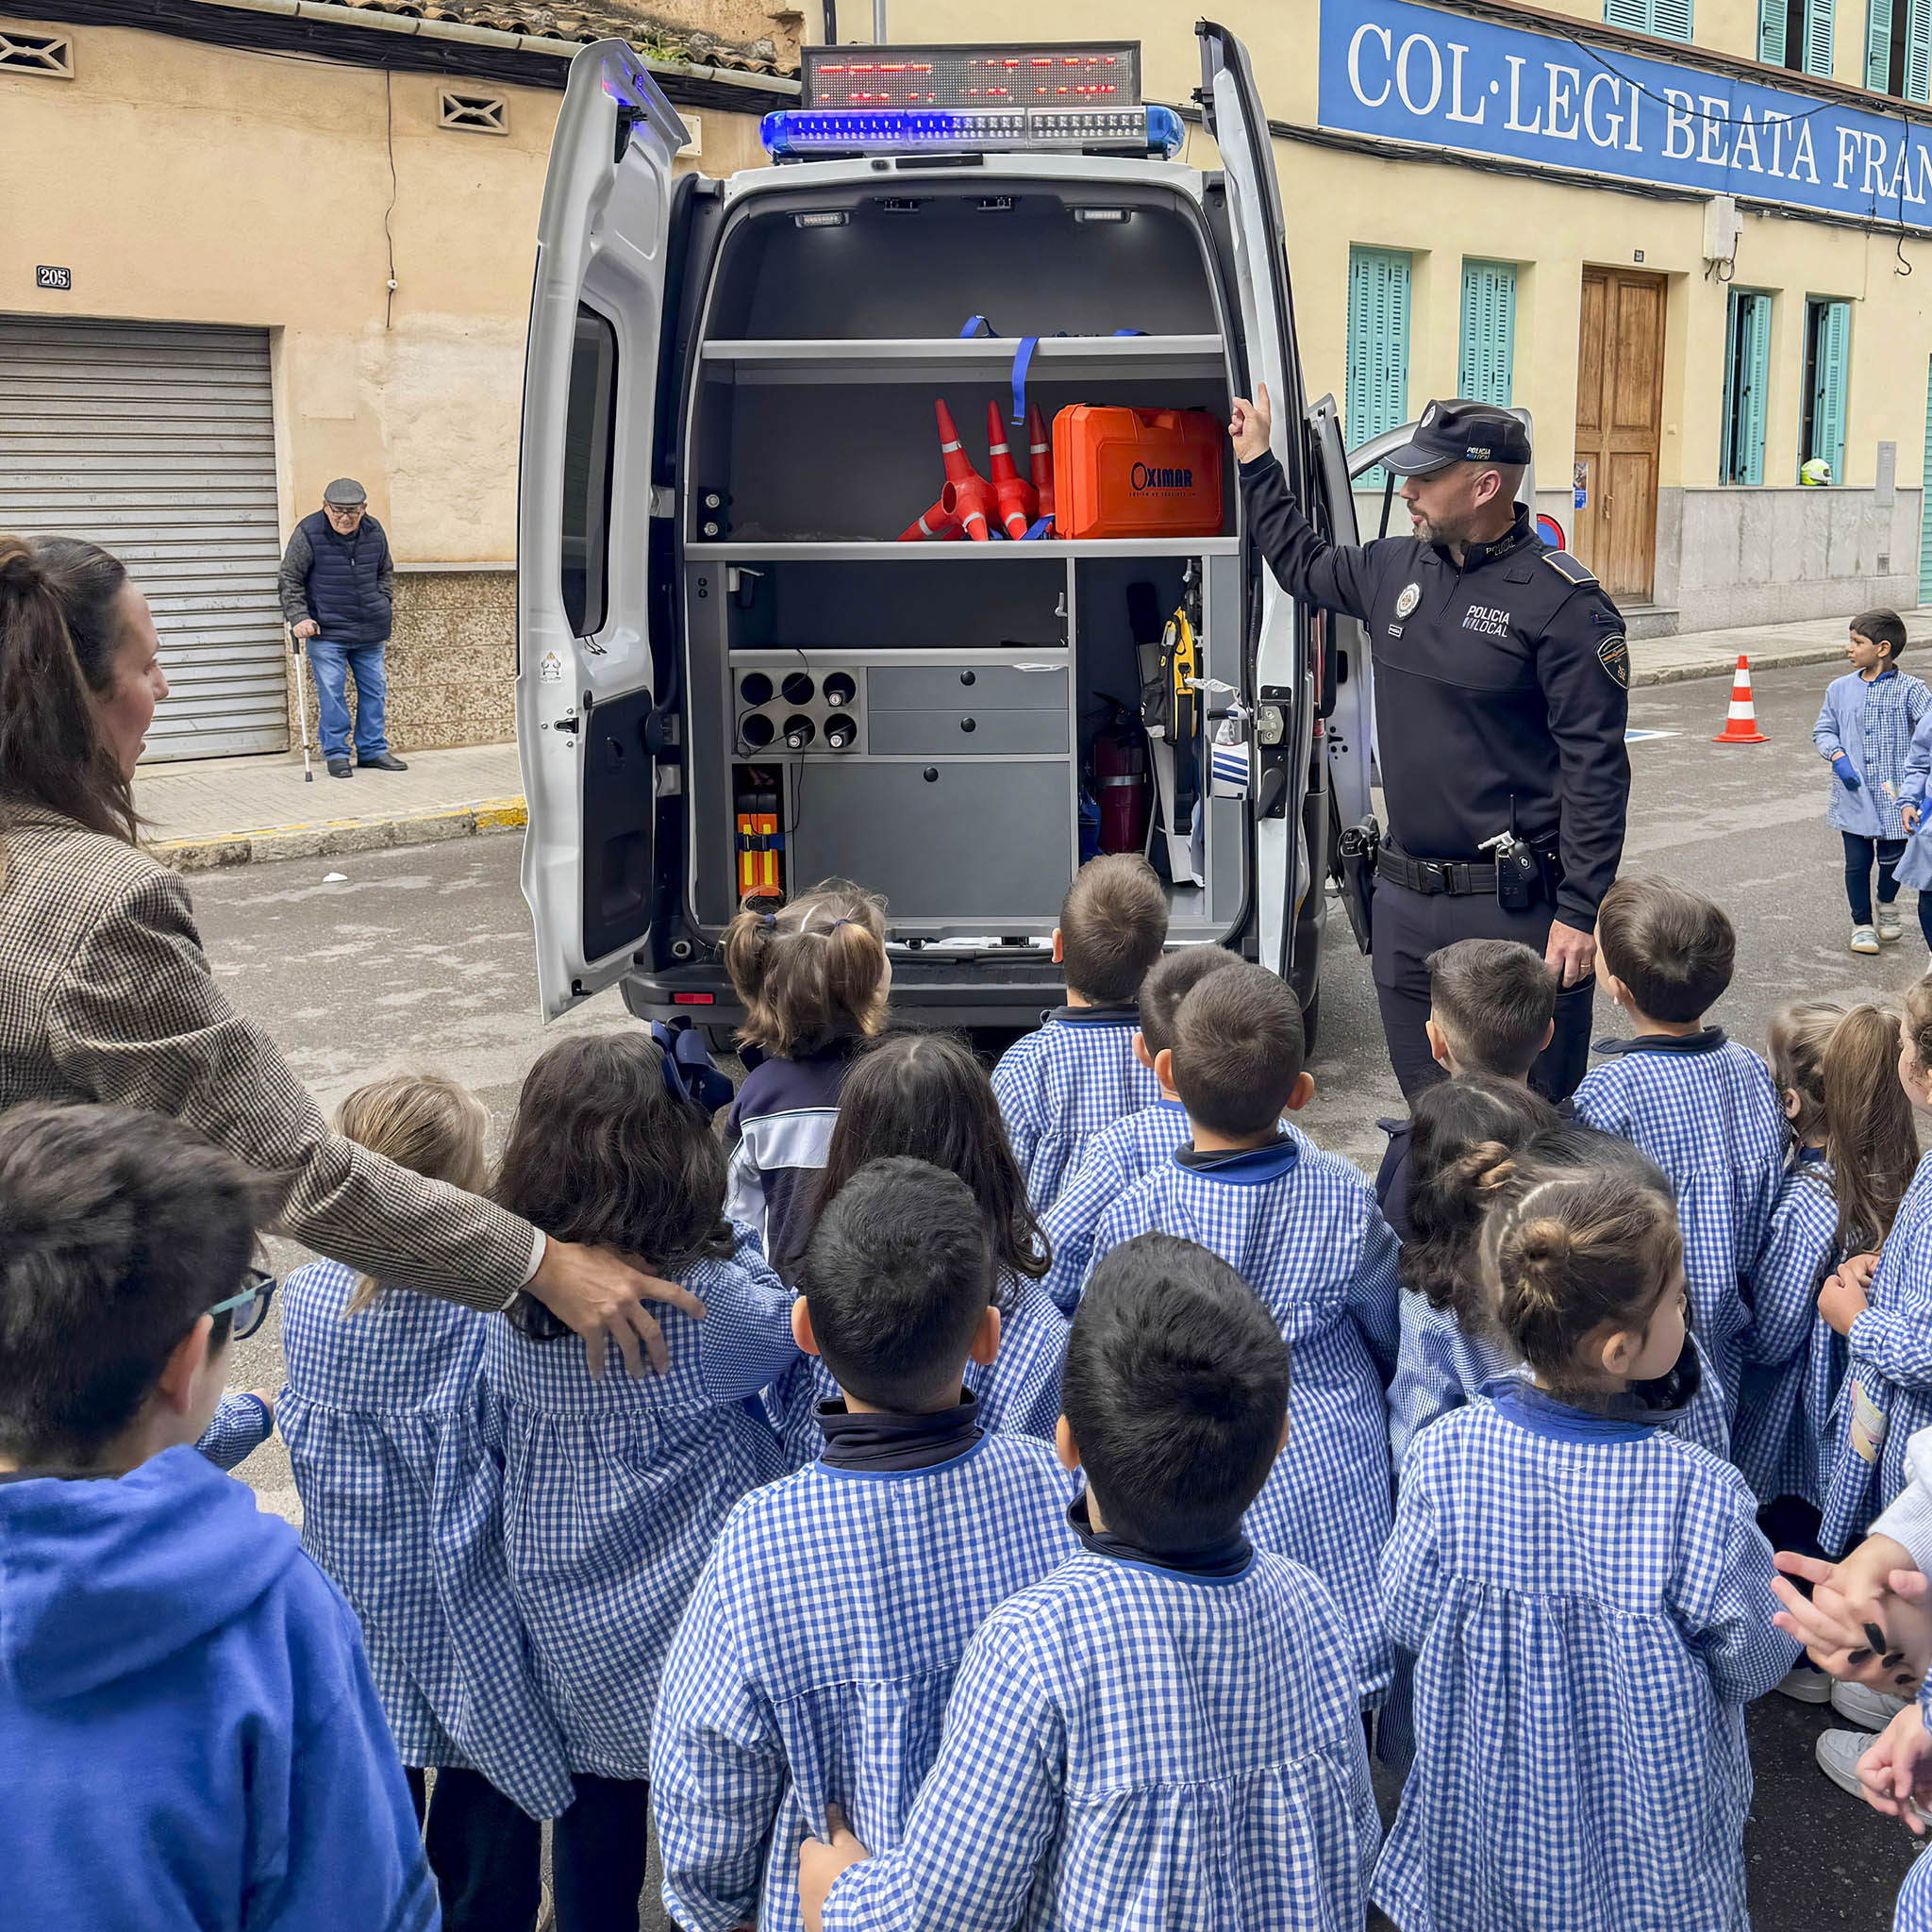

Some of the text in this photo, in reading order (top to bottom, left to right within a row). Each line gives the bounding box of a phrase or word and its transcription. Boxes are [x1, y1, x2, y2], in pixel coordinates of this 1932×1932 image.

[1348, 24, 1644, 152] COL·LEGI
[1661, 88, 1821, 185] BEATA
[41, 268, 67, 286] 205
[1466, 605, 1510, 625] POLICIA
[1473, 618, 1508, 638] LOCAL
